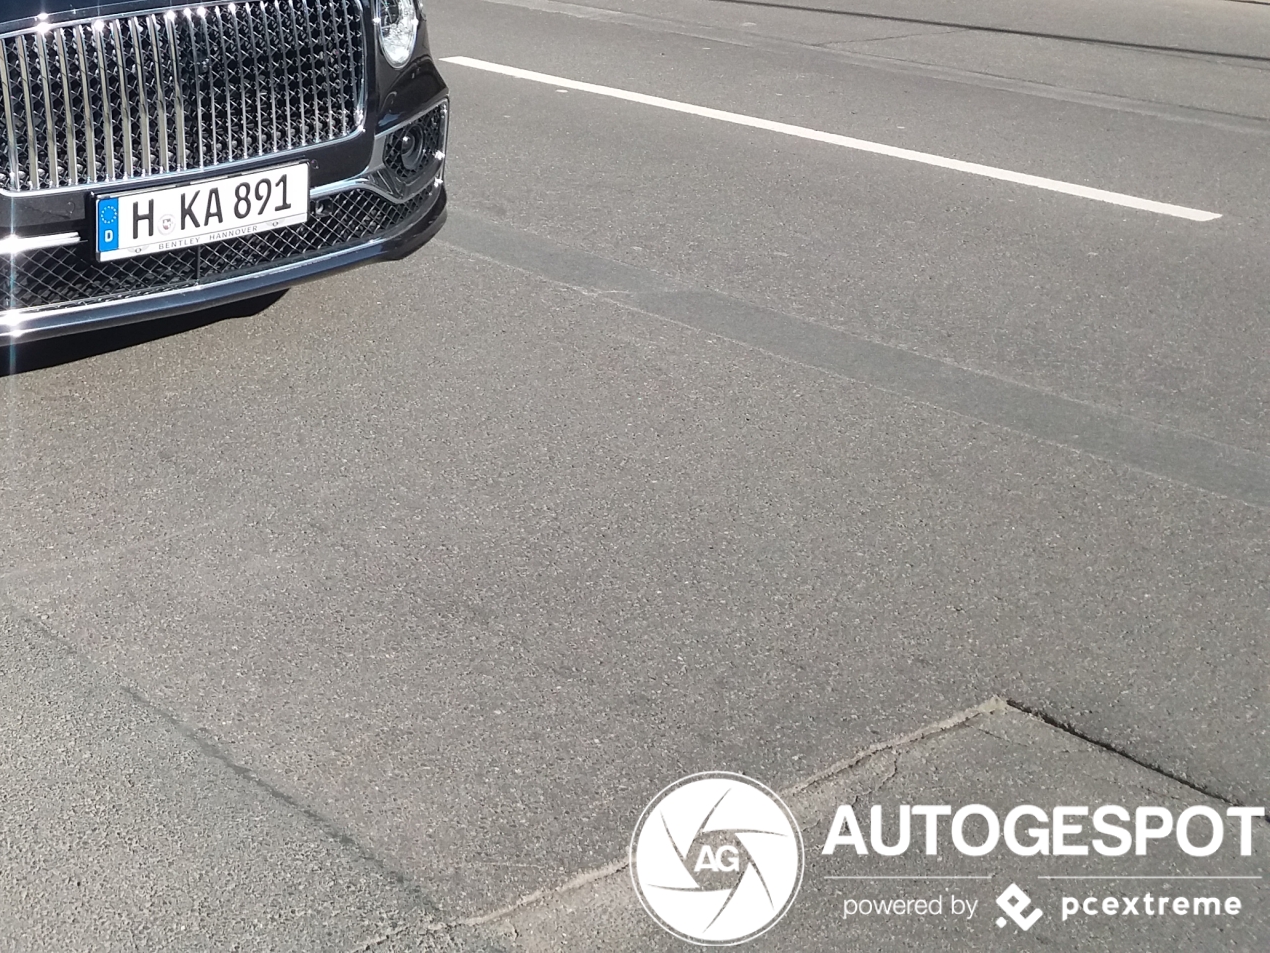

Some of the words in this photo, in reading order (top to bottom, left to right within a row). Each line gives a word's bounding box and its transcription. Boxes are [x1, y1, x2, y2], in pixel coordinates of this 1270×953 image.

[132, 198, 155, 240] H
[180, 187, 223, 230] KA
[233, 173, 292, 219] 891
[105, 230, 113, 243] D
[158, 237, 200, 250] BENTLEY
[209, 225, 258, 240] HANNOVER
